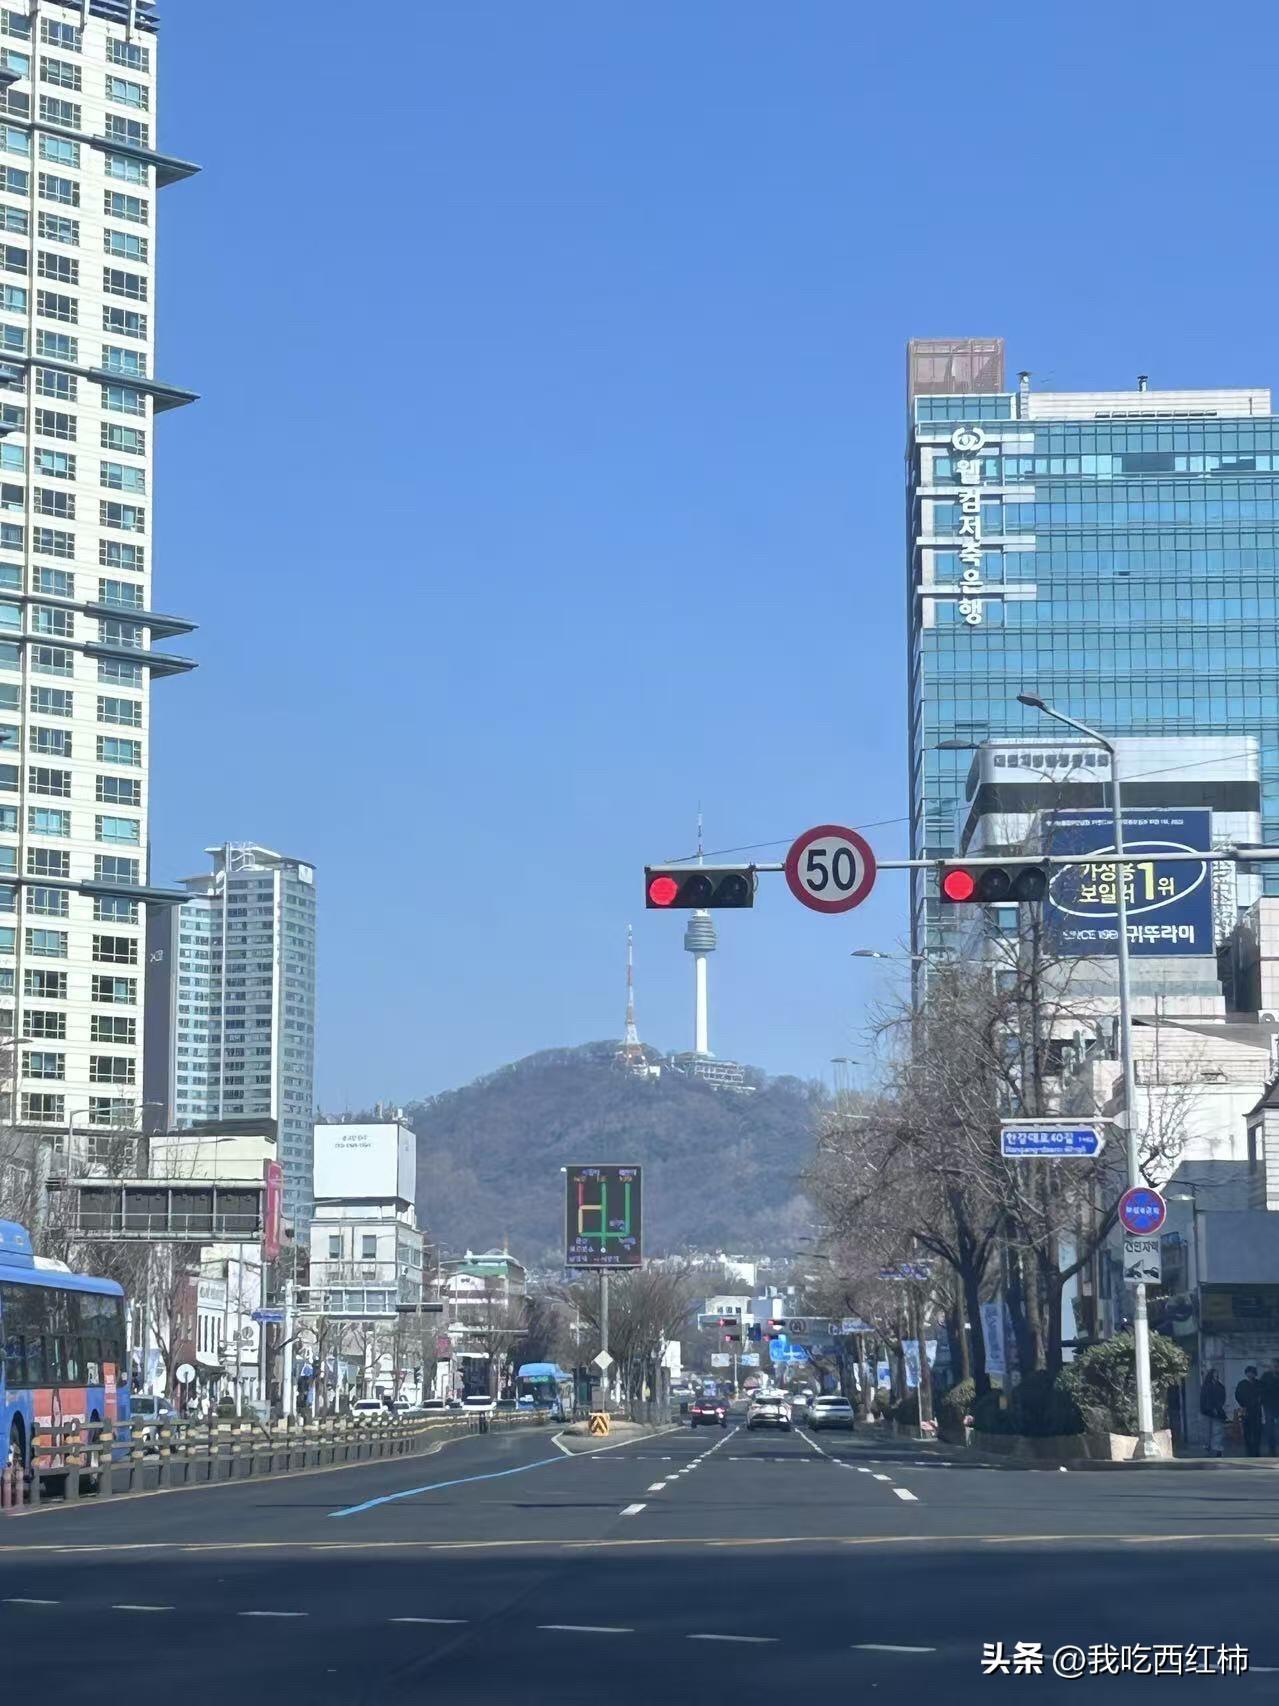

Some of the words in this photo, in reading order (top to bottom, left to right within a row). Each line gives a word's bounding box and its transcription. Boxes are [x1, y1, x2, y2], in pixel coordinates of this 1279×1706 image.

[954, 459, 984, 625] 웰컴저축은행
[806, 847, 856, 891] 50
[1127, 925, 1195, 944] 귀뚜라미
